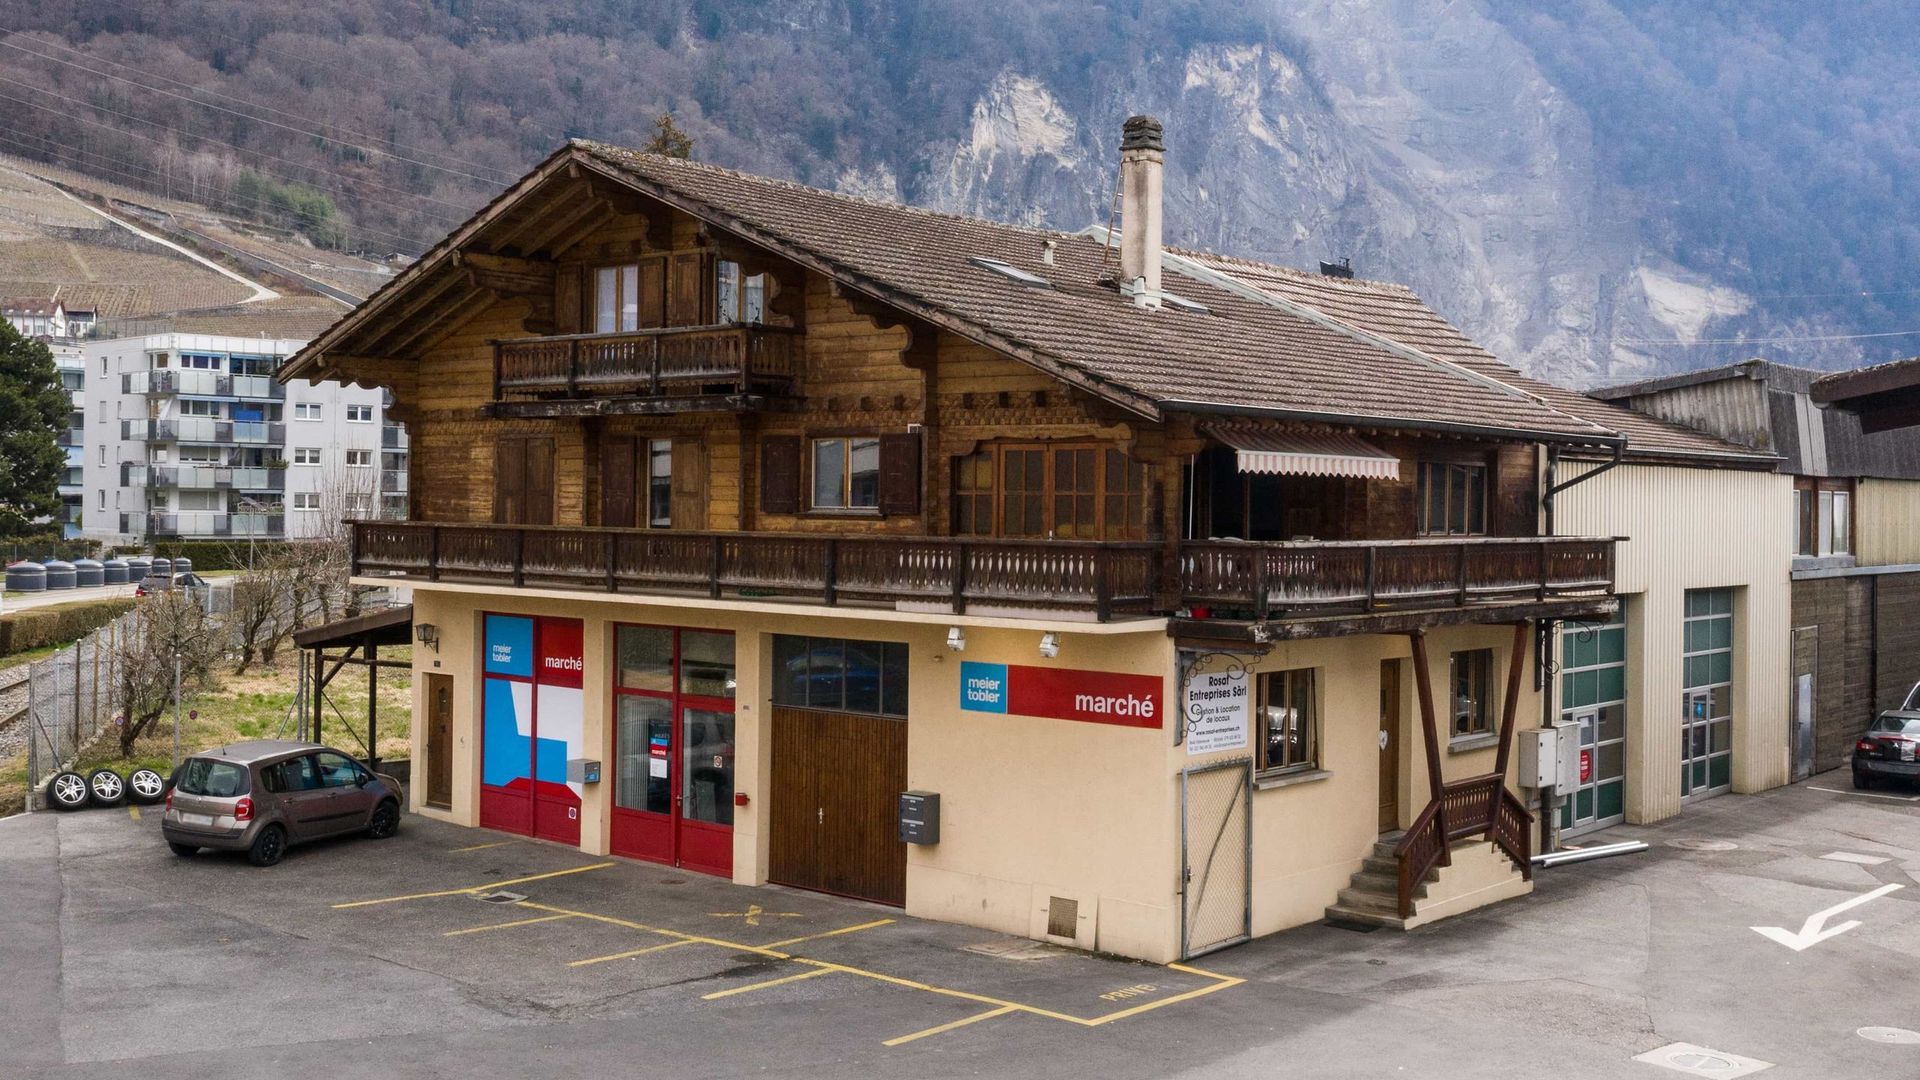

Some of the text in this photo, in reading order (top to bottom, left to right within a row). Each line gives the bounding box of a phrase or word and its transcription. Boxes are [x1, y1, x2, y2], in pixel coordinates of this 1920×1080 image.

[492, 643, 512, 654] meier
[492, 652, 512, 663] tobler
[545, 656, 583, 671] marché
[968, 677, 1000, 690] meier
[967, 688, 1000, 704] tobler
[1190, 689, 1231, 701] Entreprises
[1075, 694, 1155, 718] marché
[1220, 705, 1240, 713] Location
